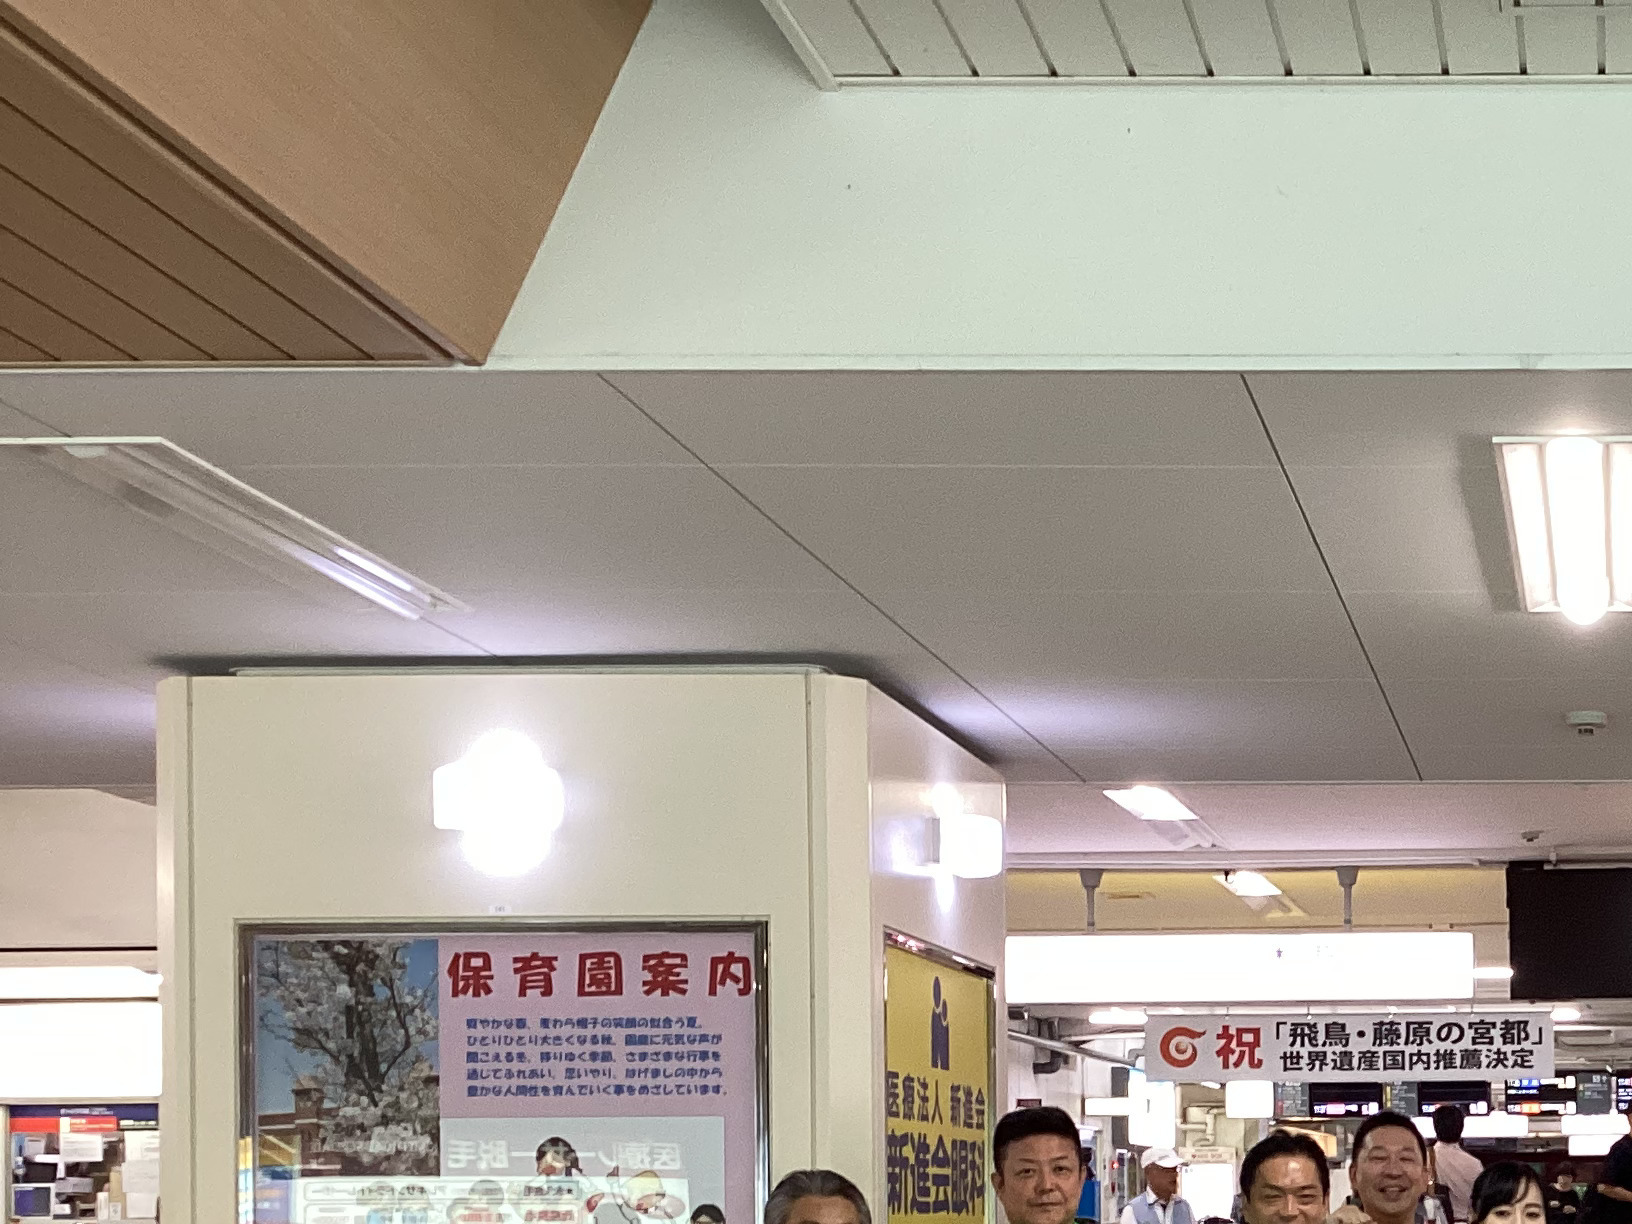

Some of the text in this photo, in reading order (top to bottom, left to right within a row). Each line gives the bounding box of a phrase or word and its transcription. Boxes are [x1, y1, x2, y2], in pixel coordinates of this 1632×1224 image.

[446, 951, 753, 998] 保育園案内
[1215, 1019, 1543, 1070] 祝 「飛鳥・藤原の宮都」
[1280, 1048, 1534, 1072] 世界遺産国内推薦決定
[888, 1071, 943, 1125] 医療法人
[888, 1128, 985, 1217] 新進会眼科
